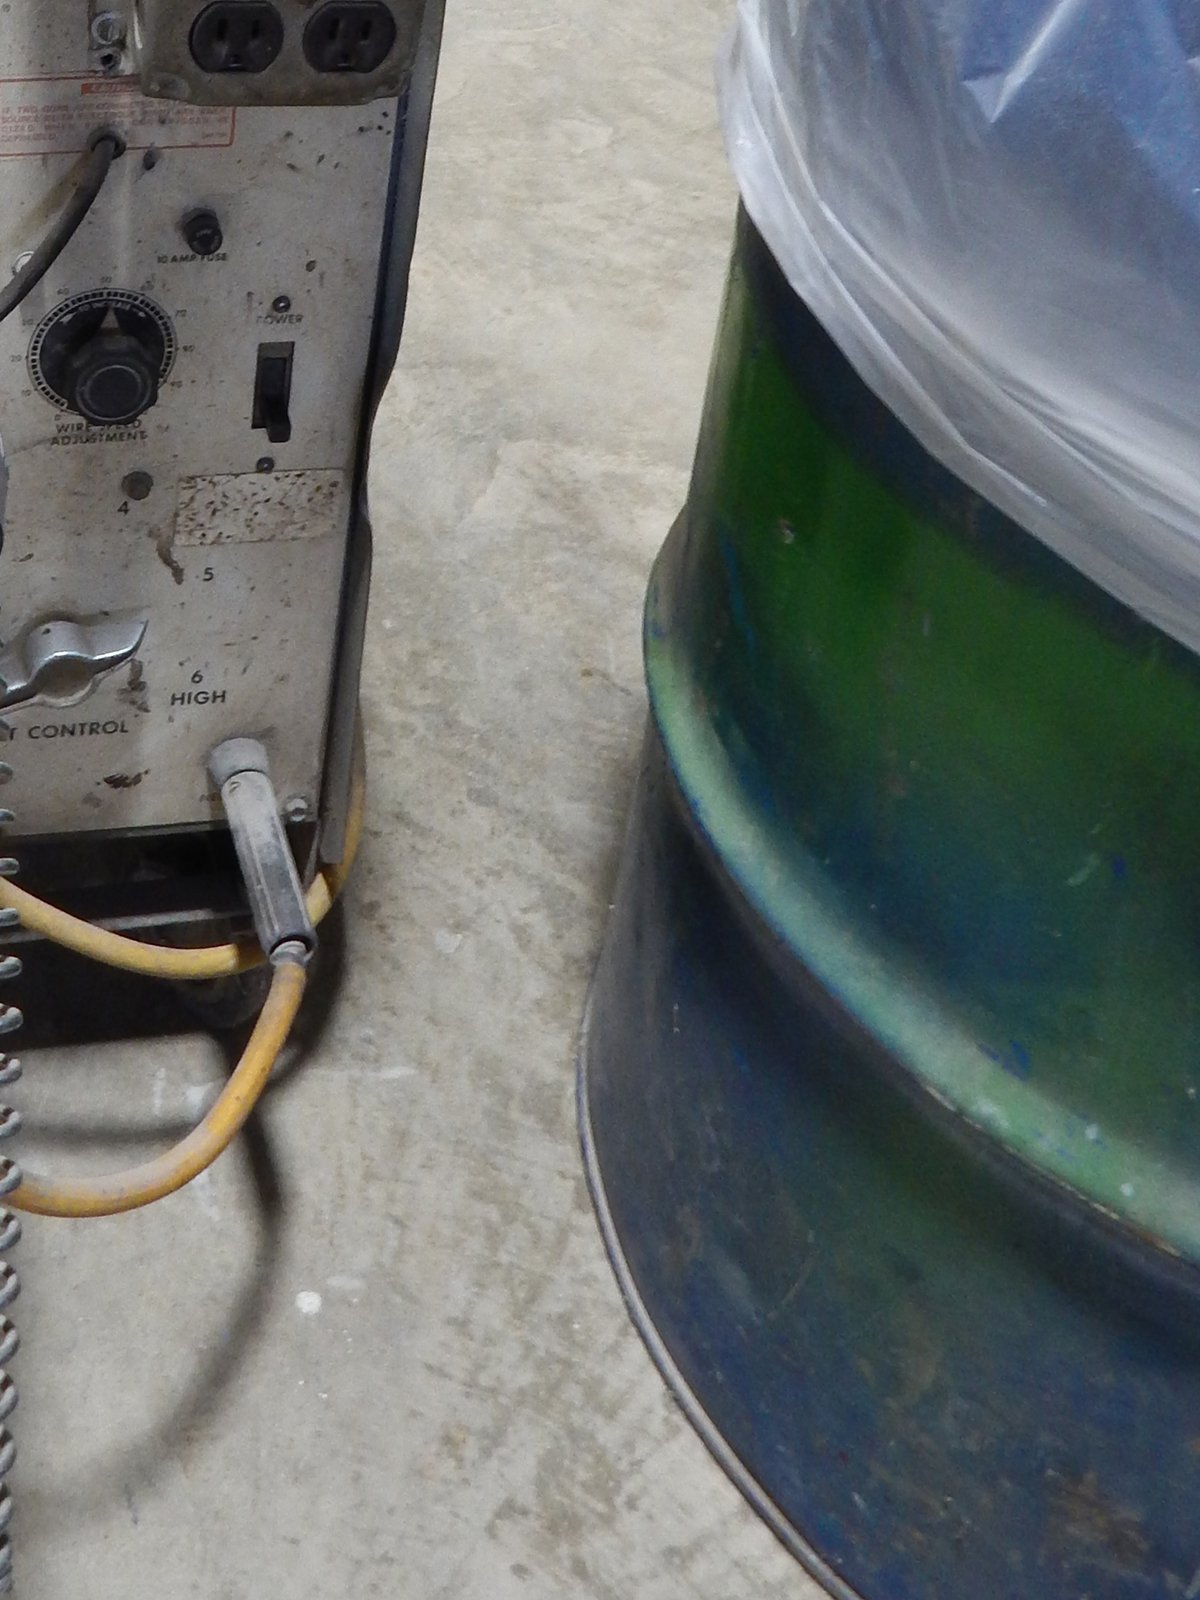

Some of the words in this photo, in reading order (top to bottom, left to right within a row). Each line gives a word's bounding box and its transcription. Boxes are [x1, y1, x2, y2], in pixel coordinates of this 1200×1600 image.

[171, 254, 196, 263] AMP
[199, 252, 228, 262] FUSE
[256, 314, 303, 325] POWER
[56, 422, 93, 434] WIRE
[50, 430, 148, 445] ADJUSTMENT
[117, 501, 130, 515] 4
[203, 567, 215, 581] 5
[191, 669, 204, 684] 6
[170, 690, 227, 706] HIGH
[27, 720, 130, 739] CONTROL
